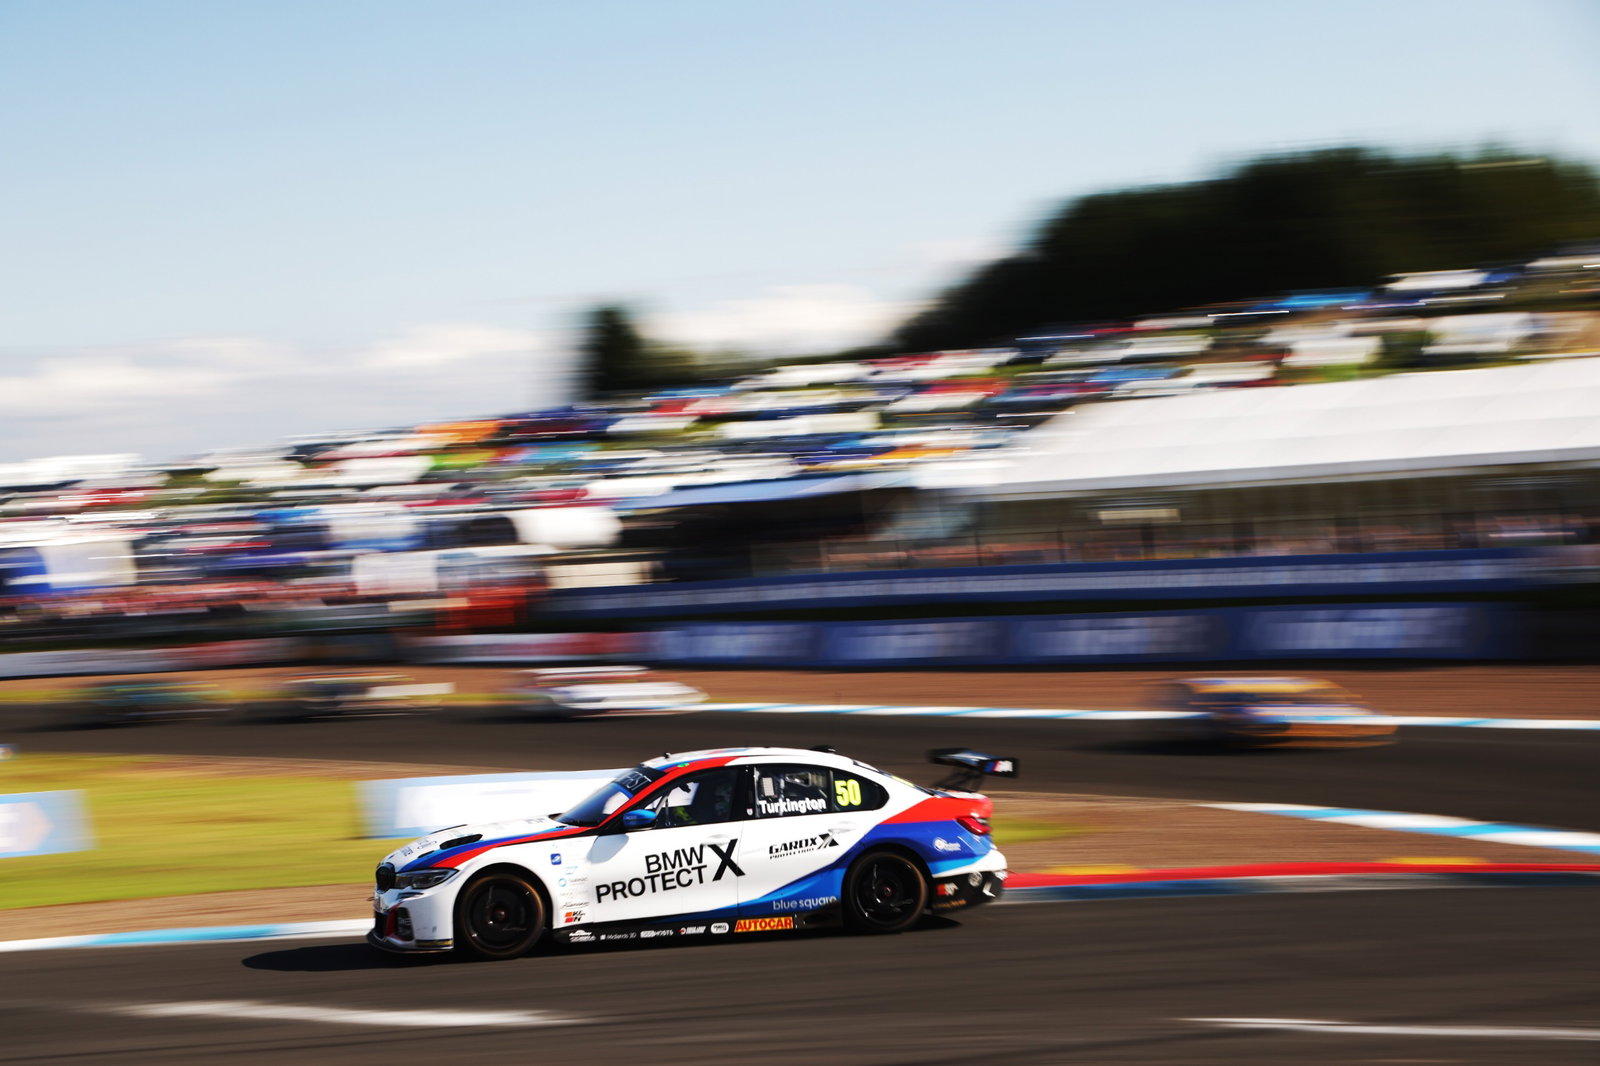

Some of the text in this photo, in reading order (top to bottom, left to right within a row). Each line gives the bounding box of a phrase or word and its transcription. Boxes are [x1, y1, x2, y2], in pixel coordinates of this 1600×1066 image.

[759, 797, 827, 815] Turkington
[834, 779, 862, 807] 50
[645, 844, 704, 874] BMW
[708, 838, 746, 882] X
[595, 865, 708, 904] PROTECT
[772, 900, 798, 911] blue
[736, 918, 792, 931] AUTOCAR
